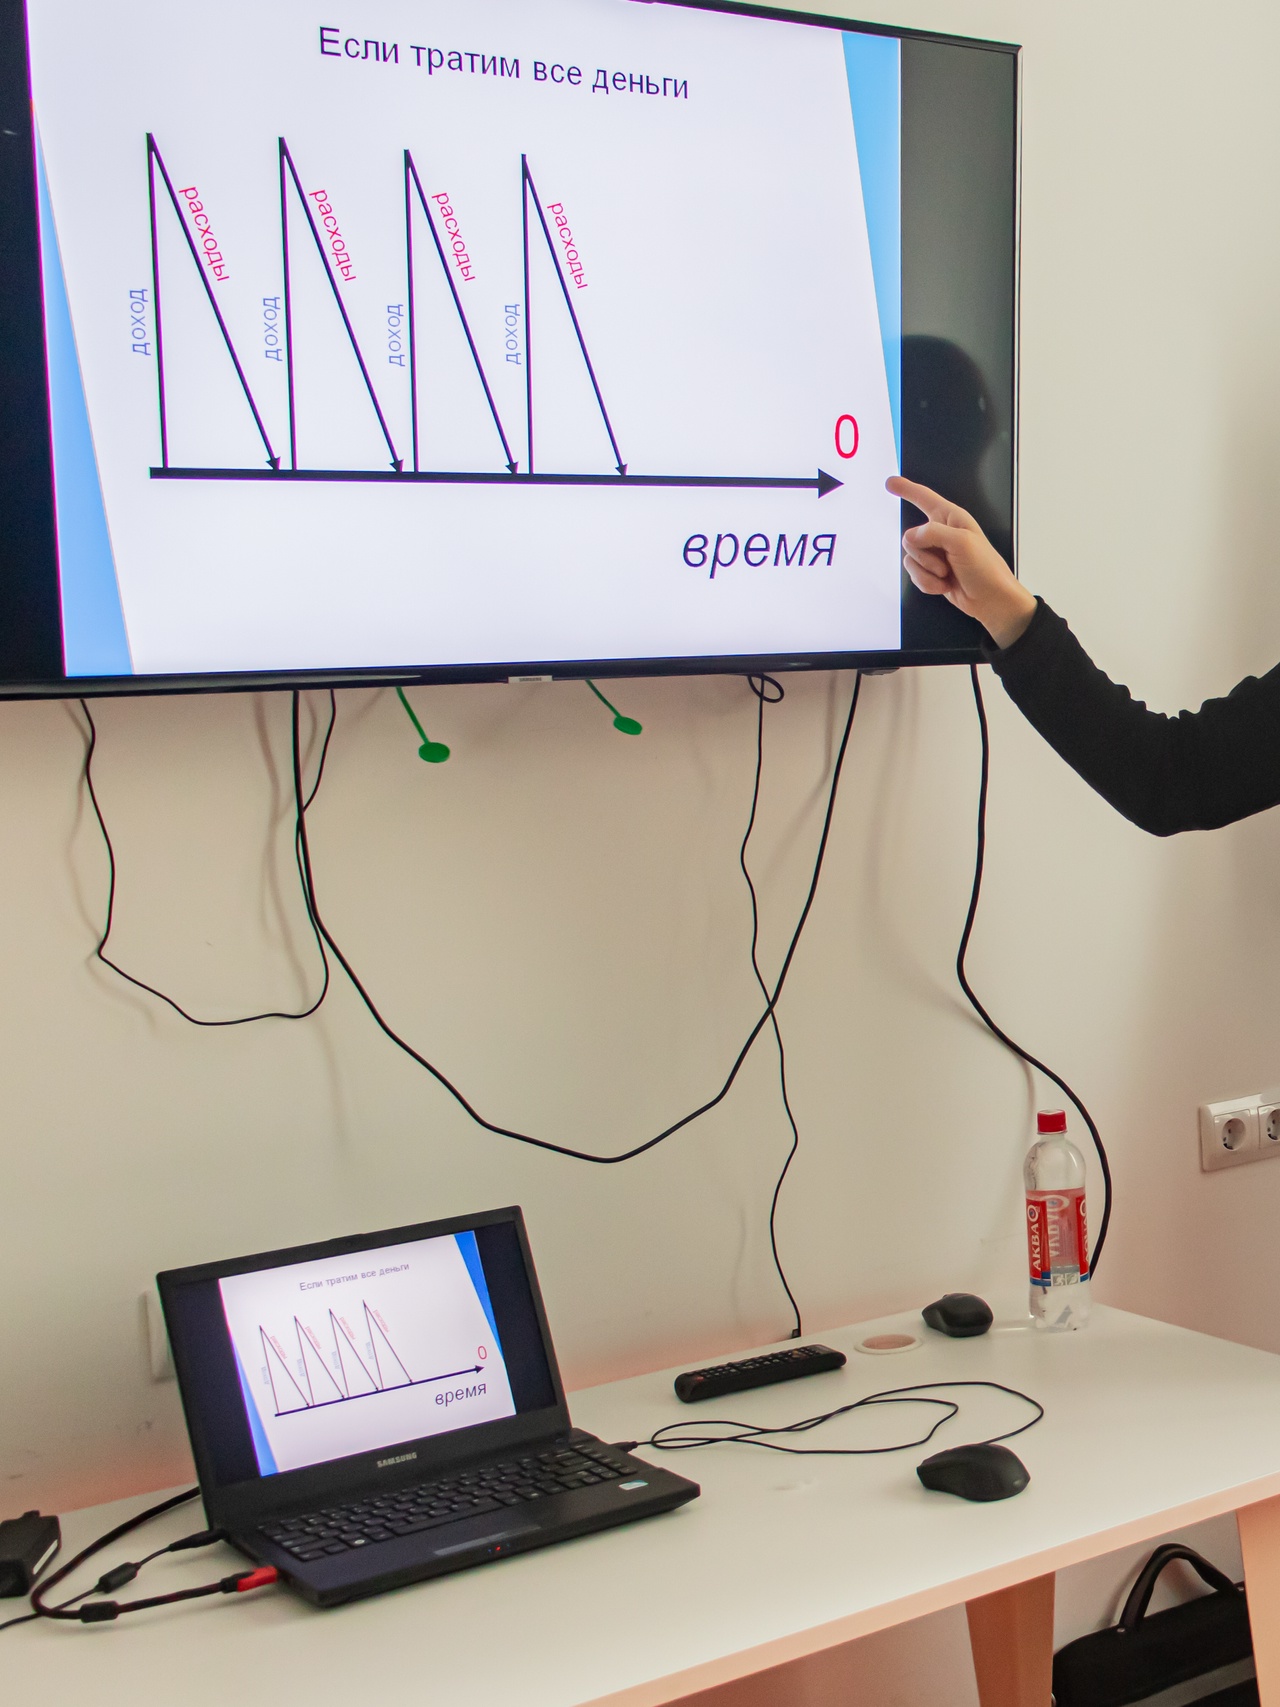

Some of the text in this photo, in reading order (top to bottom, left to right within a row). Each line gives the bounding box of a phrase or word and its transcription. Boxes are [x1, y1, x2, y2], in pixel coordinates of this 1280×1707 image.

[319, 26, 690, 100] Если тратим все деньги
[178, 186, 230, 282] расходы
[309, 189, 356, 282] расходы
[431, 192, 475, 282] расходы
[546, 202, 588, 289] расходы
[129, 288, 151, 356] доход
[262, 296, 283, 362] доход
[386, 303, 405, 367] доход
[504, 303, 521, 365] доход
[834, 413, 860, 460] 0
[682, 531, 838, 579] время
[299, 1263, 410, 1292] Если тратим все деньги
[477, 1345, 488, 1361] 0
[435, 1382, 488, 1408] время
[377, 1452, 418, 1468] SAMSUNG
